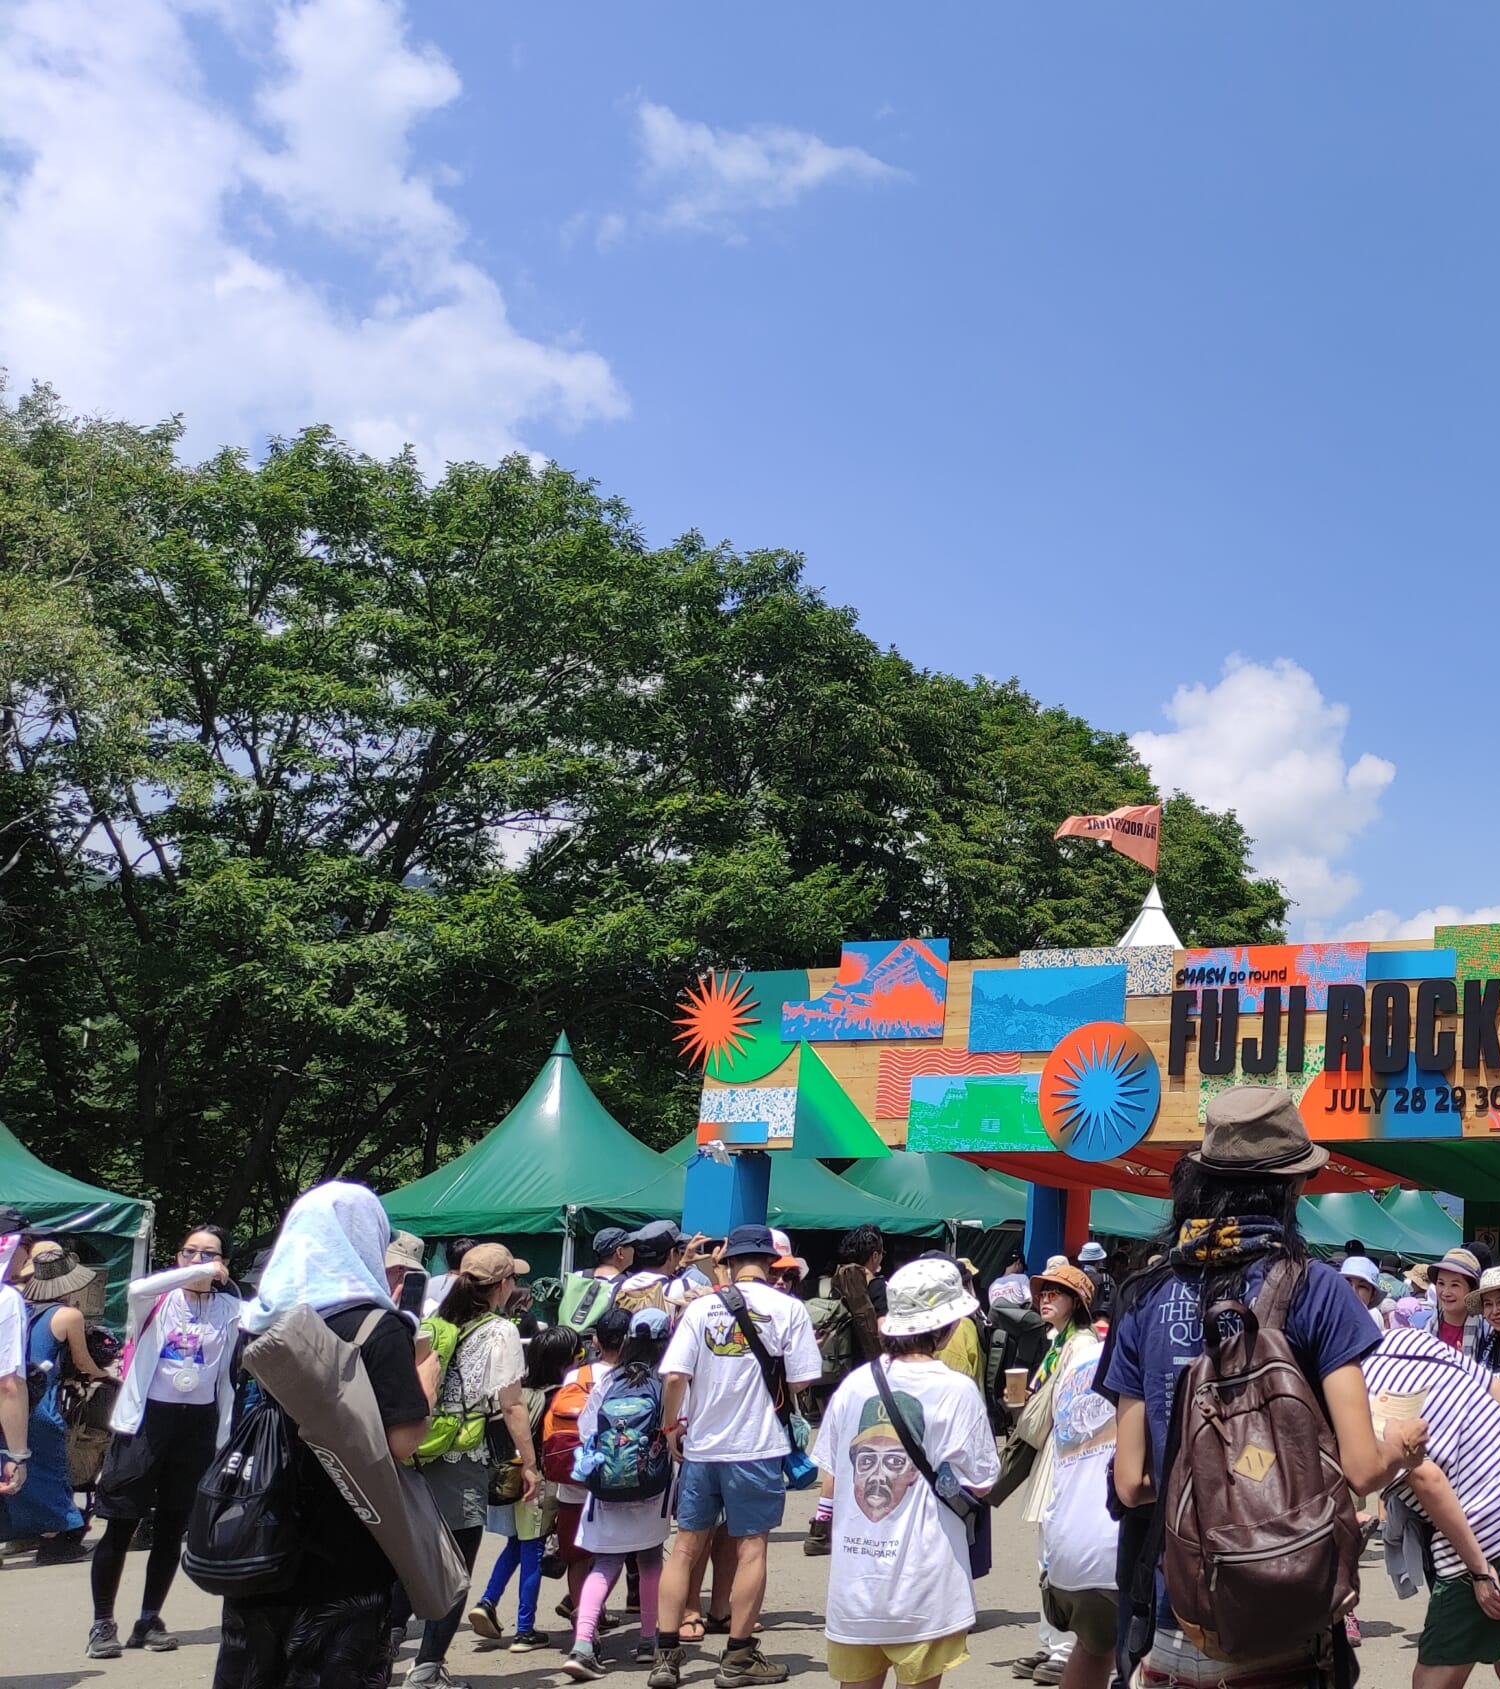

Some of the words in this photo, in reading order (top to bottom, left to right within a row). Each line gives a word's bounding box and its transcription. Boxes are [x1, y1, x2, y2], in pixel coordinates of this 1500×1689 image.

[1176, 966, 1227, 985] SMASH
[1229, 970, 1246, 985] go
[1249, 966, 1287, 983] round
[1168, 985, 1306, 1075] FUJI
[1324, 1087, 1386, 1114] JULY
[1394, 1086, 1427, 1113] 28
[1434, 1086, 1466, 1113] 29
[1159, 1301, 1199, 1324] THE
[843, 1535, 861, 1546] TAKE
[889, 1539, 899, 1548] TO
[843, 1545, 859, 1555] THE
